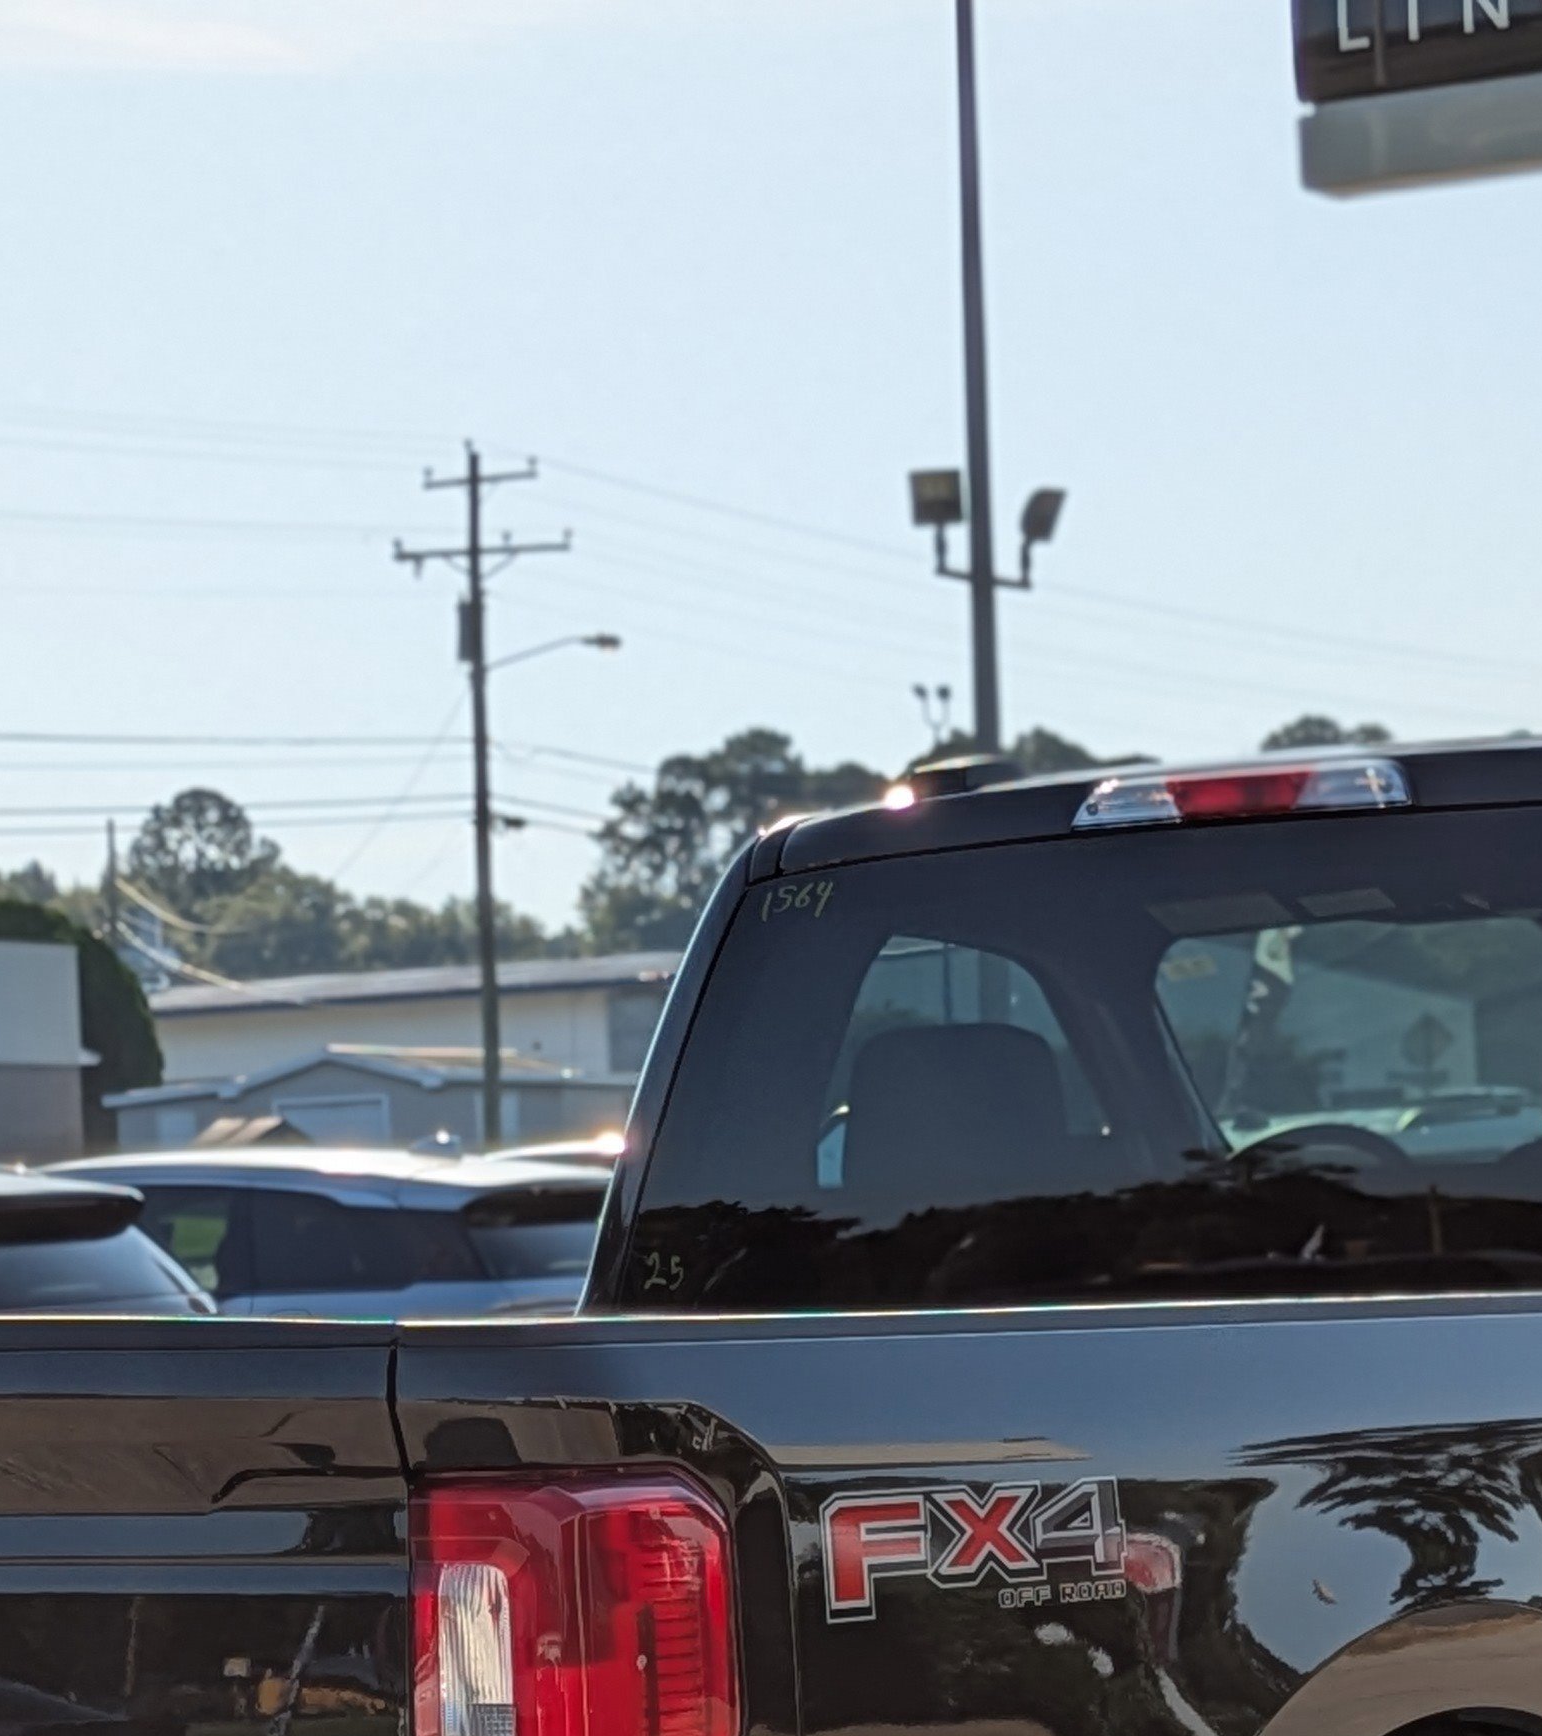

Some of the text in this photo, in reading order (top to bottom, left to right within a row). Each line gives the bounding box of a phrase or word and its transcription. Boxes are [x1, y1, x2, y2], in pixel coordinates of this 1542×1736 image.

[820, 1476, 1126, 1624] FX4
[998, 1579, 1126, 1608] OFF ROAD
